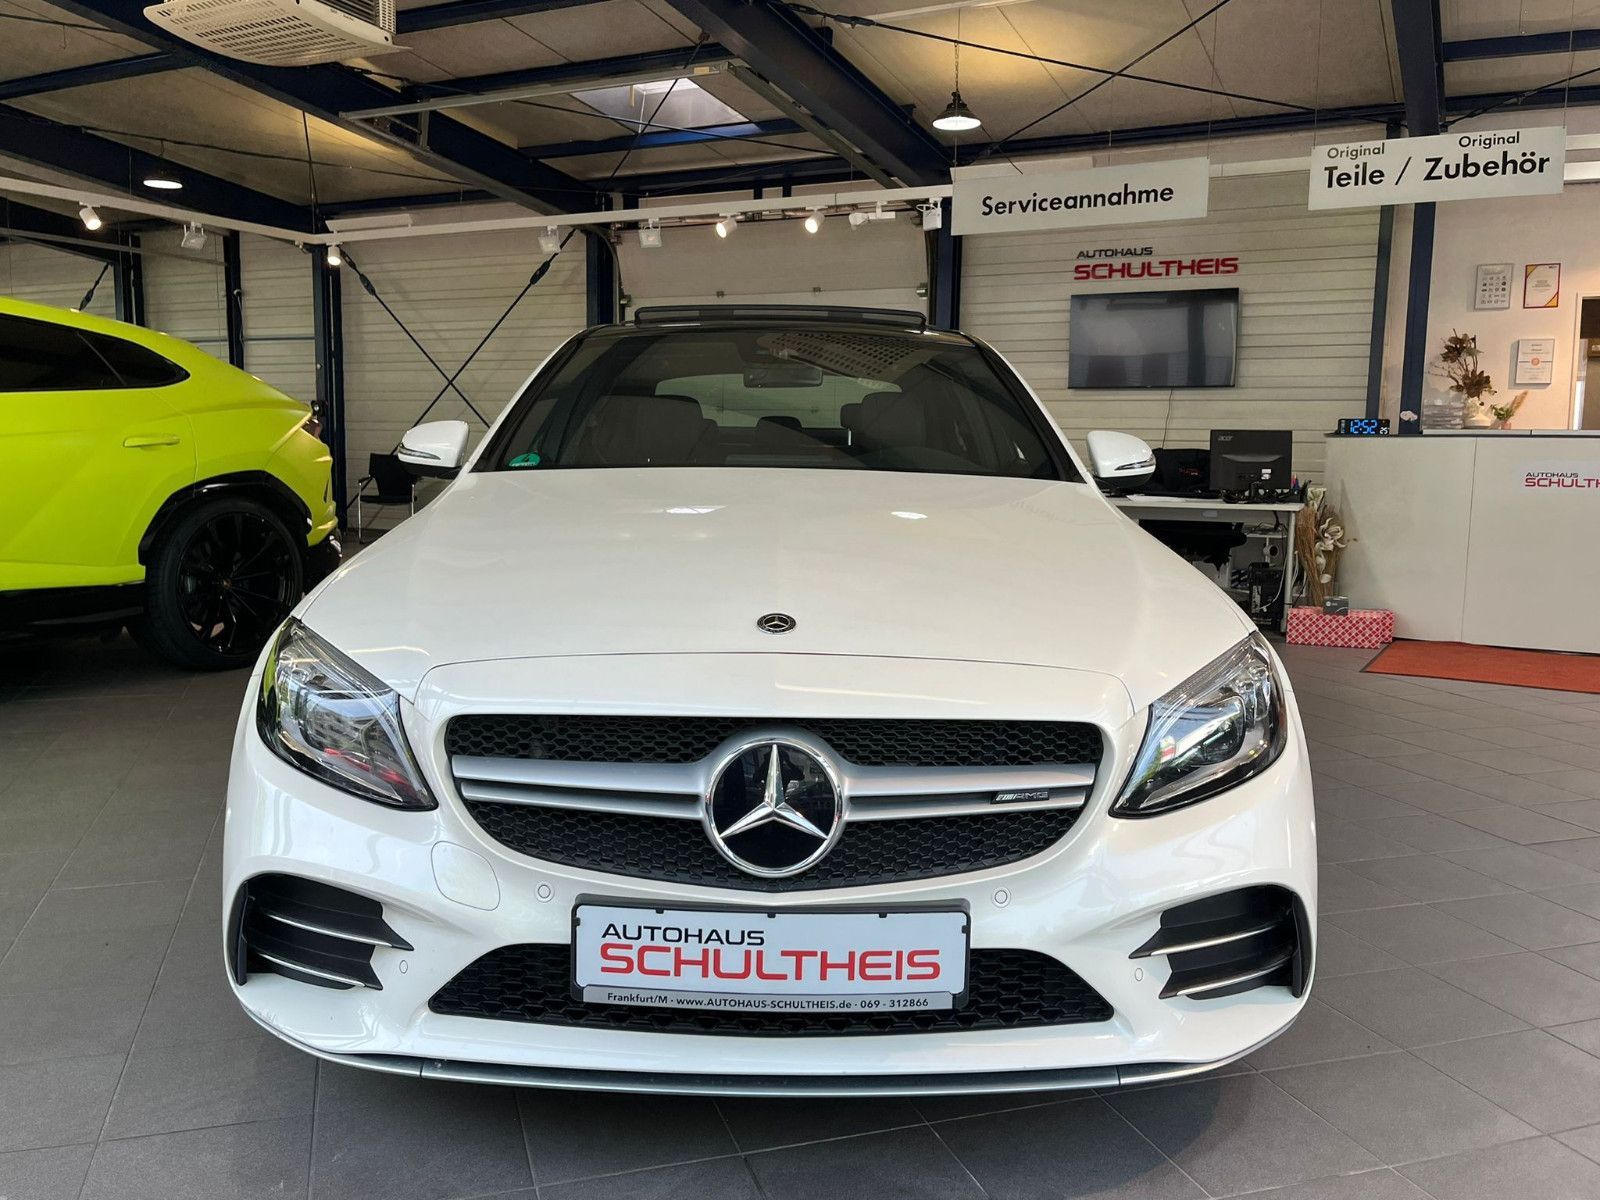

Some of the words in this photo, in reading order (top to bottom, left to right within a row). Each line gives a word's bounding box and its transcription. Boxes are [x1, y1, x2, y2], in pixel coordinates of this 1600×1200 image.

[1327, 142, 1385, 160] Original
[1458, 131, 1520, 149] Original
[1324, 162, 1385, 188] Teile
[1423, 150, 1550, 181] Zubehör
[981, 183, 1174, 216] Serviceannahme
[1076, 247, 1153, 259] AUTOHAUS
[1074, 257, 1239, 280] SCHULTHEIS
[1350, 419, 1378, 434] 12:52
[601, 923, 765, 946] AUTOHAUS
[600, 942, 941, 981] SCHULTHEIS
[607, 992, 668, 1004] Frankfurt/M
[676, 998, 851, 1009] www.AUTOHAUS-SCHULTHEIS.de
[860, 1000, 880, 1009] 069
[889, 998, 929, 1008] 312866
